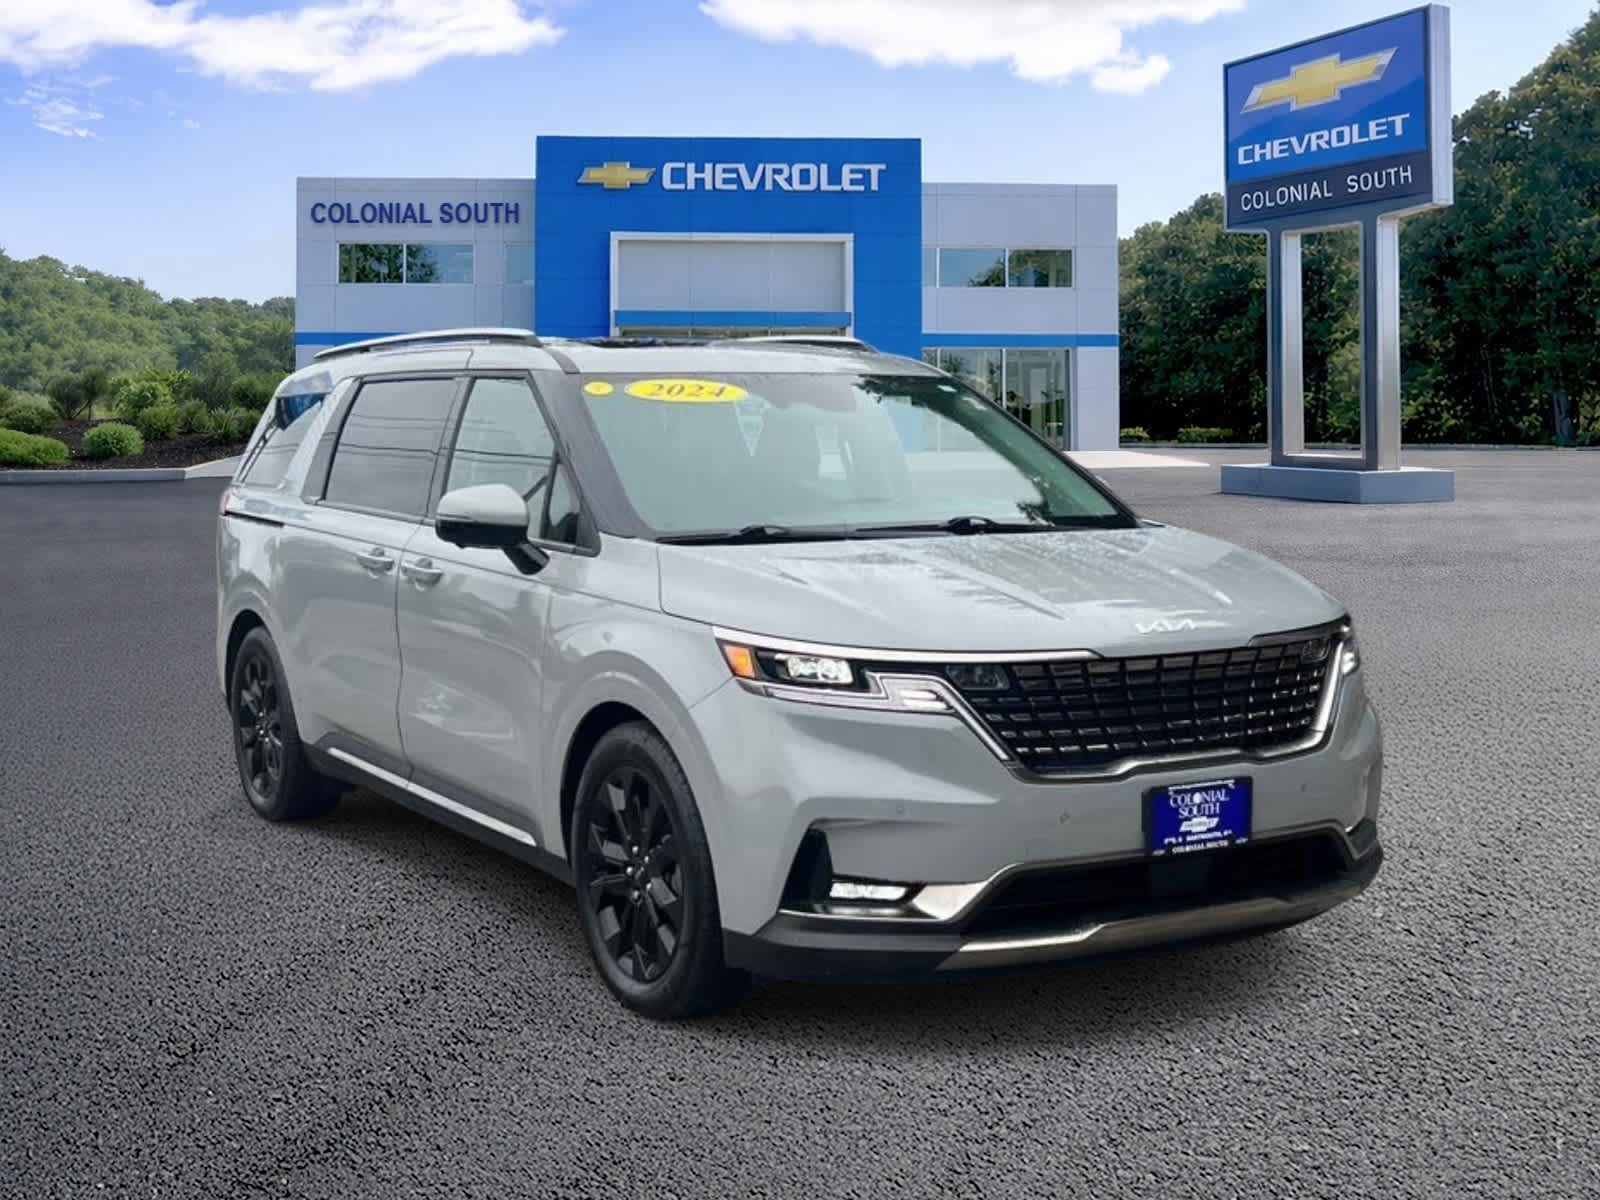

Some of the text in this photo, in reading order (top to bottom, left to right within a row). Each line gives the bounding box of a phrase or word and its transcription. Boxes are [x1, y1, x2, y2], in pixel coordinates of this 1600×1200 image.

[1238, 113, 1410, 165] CHEVROLET
[661, 162, 887, 192] CHEVROLET
[1241, 165, 1413, 211] COLONIAL SOUTH
[310, 202, 521, 225] COLONIAL SOUTH
[647, 382, 727, 398] 2024
[1169, 789, 1230, 808] COLONIAL
[1178, 802, 1220, 819] SOUTH
